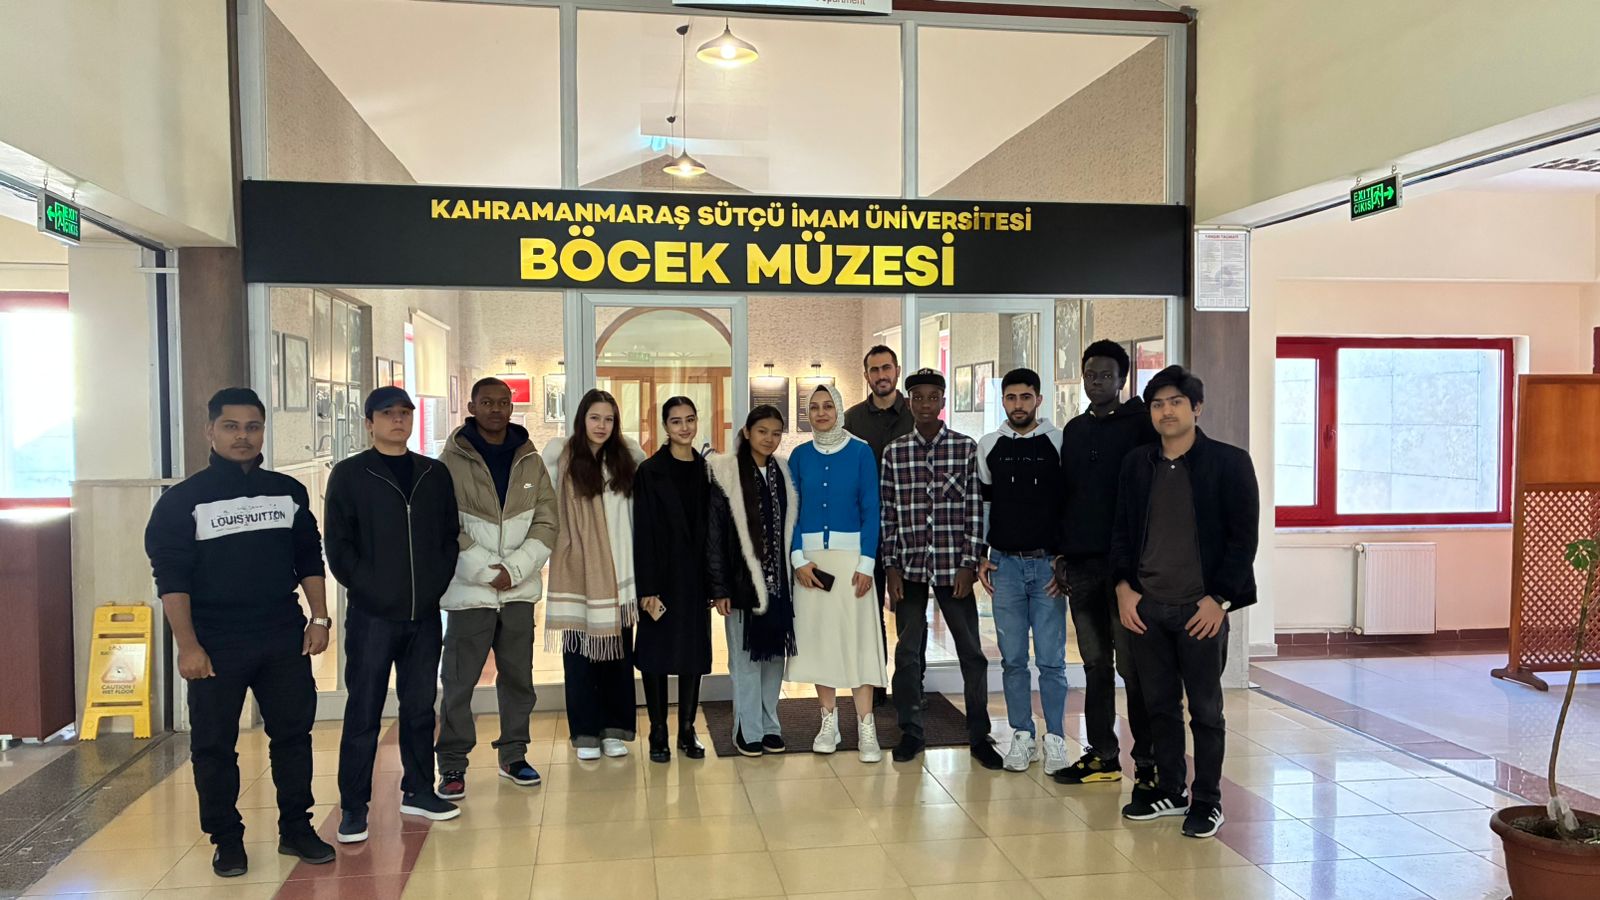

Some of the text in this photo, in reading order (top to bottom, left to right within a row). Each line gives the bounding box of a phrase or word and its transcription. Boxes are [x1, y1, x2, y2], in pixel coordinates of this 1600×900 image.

[1354, 187, 1371, 202] EXIT
[64, 206, 78, 221] EXIT
[431, 199, 1032, 232] KAHRAMANMARAŞ SÜTÇÜ İMAM ÜNİVERSİTESİ
[520, 225, 954, 287] BÖCEK MÜZESİ
[211, 514, 244, 528] LOUIS
